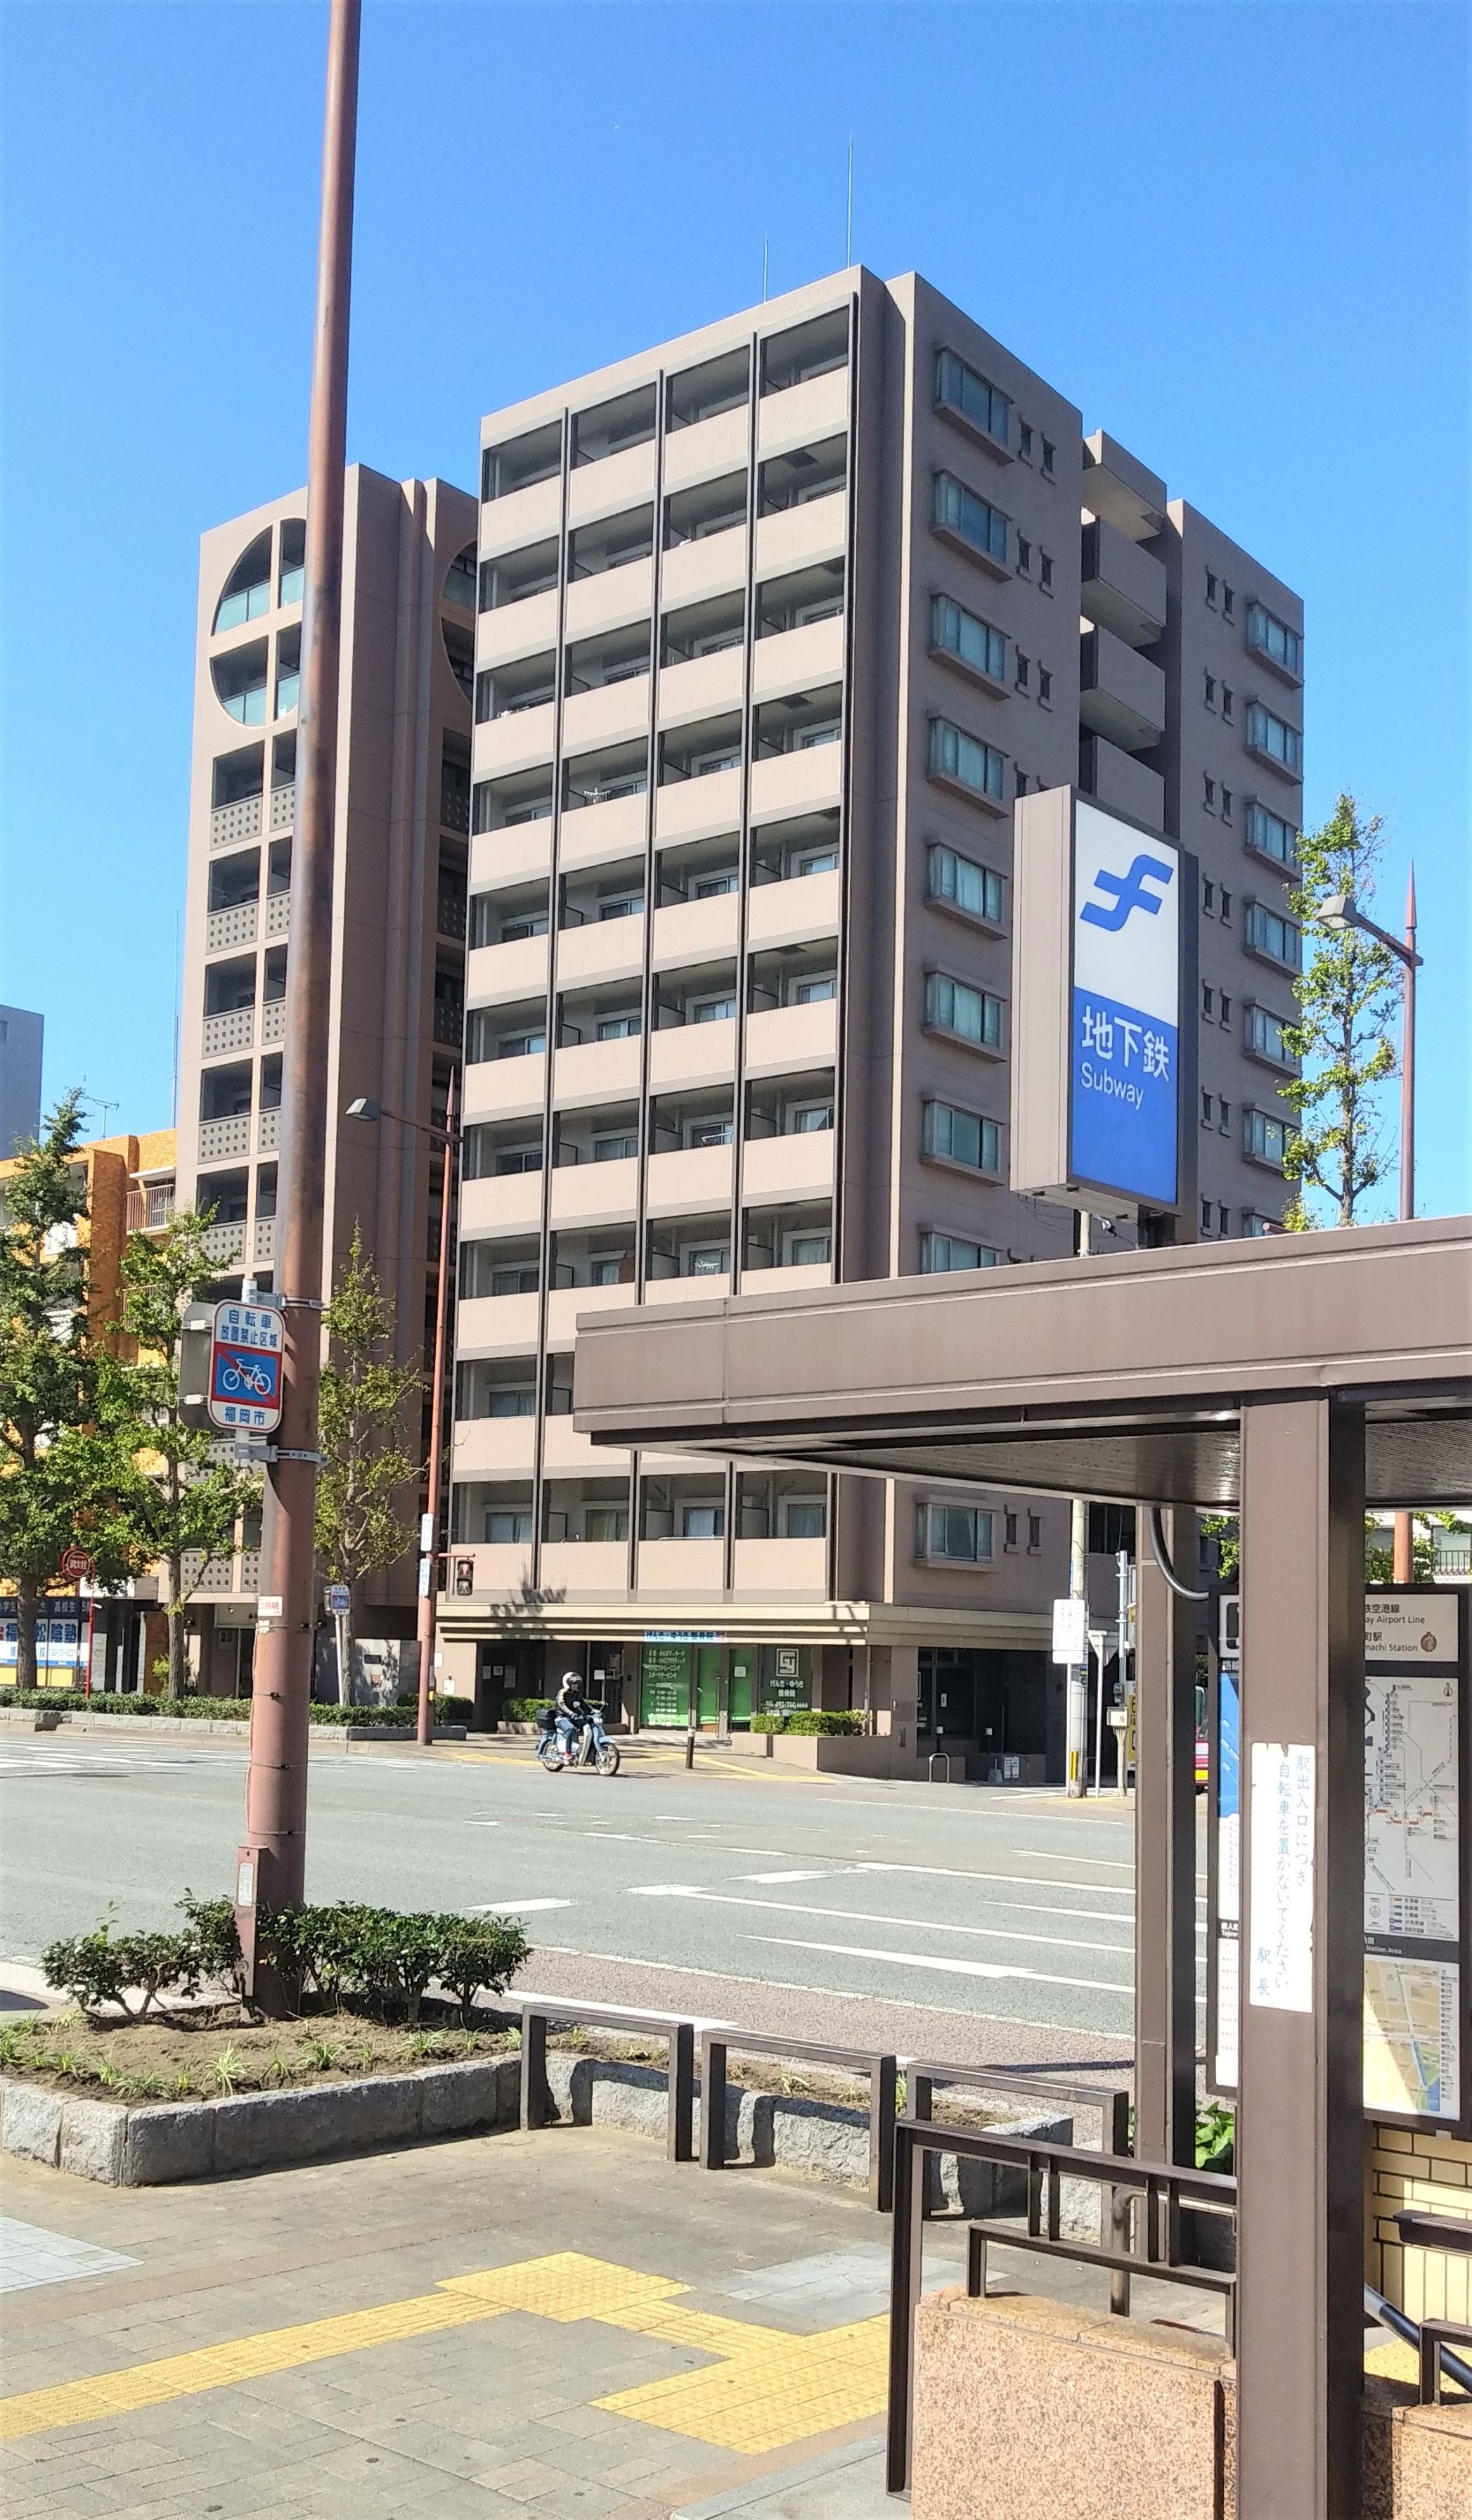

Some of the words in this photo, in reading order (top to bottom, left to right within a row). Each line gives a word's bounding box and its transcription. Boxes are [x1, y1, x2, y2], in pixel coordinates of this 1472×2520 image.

[1081, 1004, 1170, 1084] 地下鉄
[1080, 1062, 1144, 1110] Subway
[228, 1309, 272, 1329] 自転車
[221, 1325, 278, 1348] 放置禁止区域
[225, 1406, 266, 1426] 福岡市
[1376, 1615, 1406, 1625] Airport
[1407, 1615, 1426, 1624] Line
[1389, 1643, 1418, 1652] Station
[1296, 1755, 1311, 1886] 駅出入口につき
